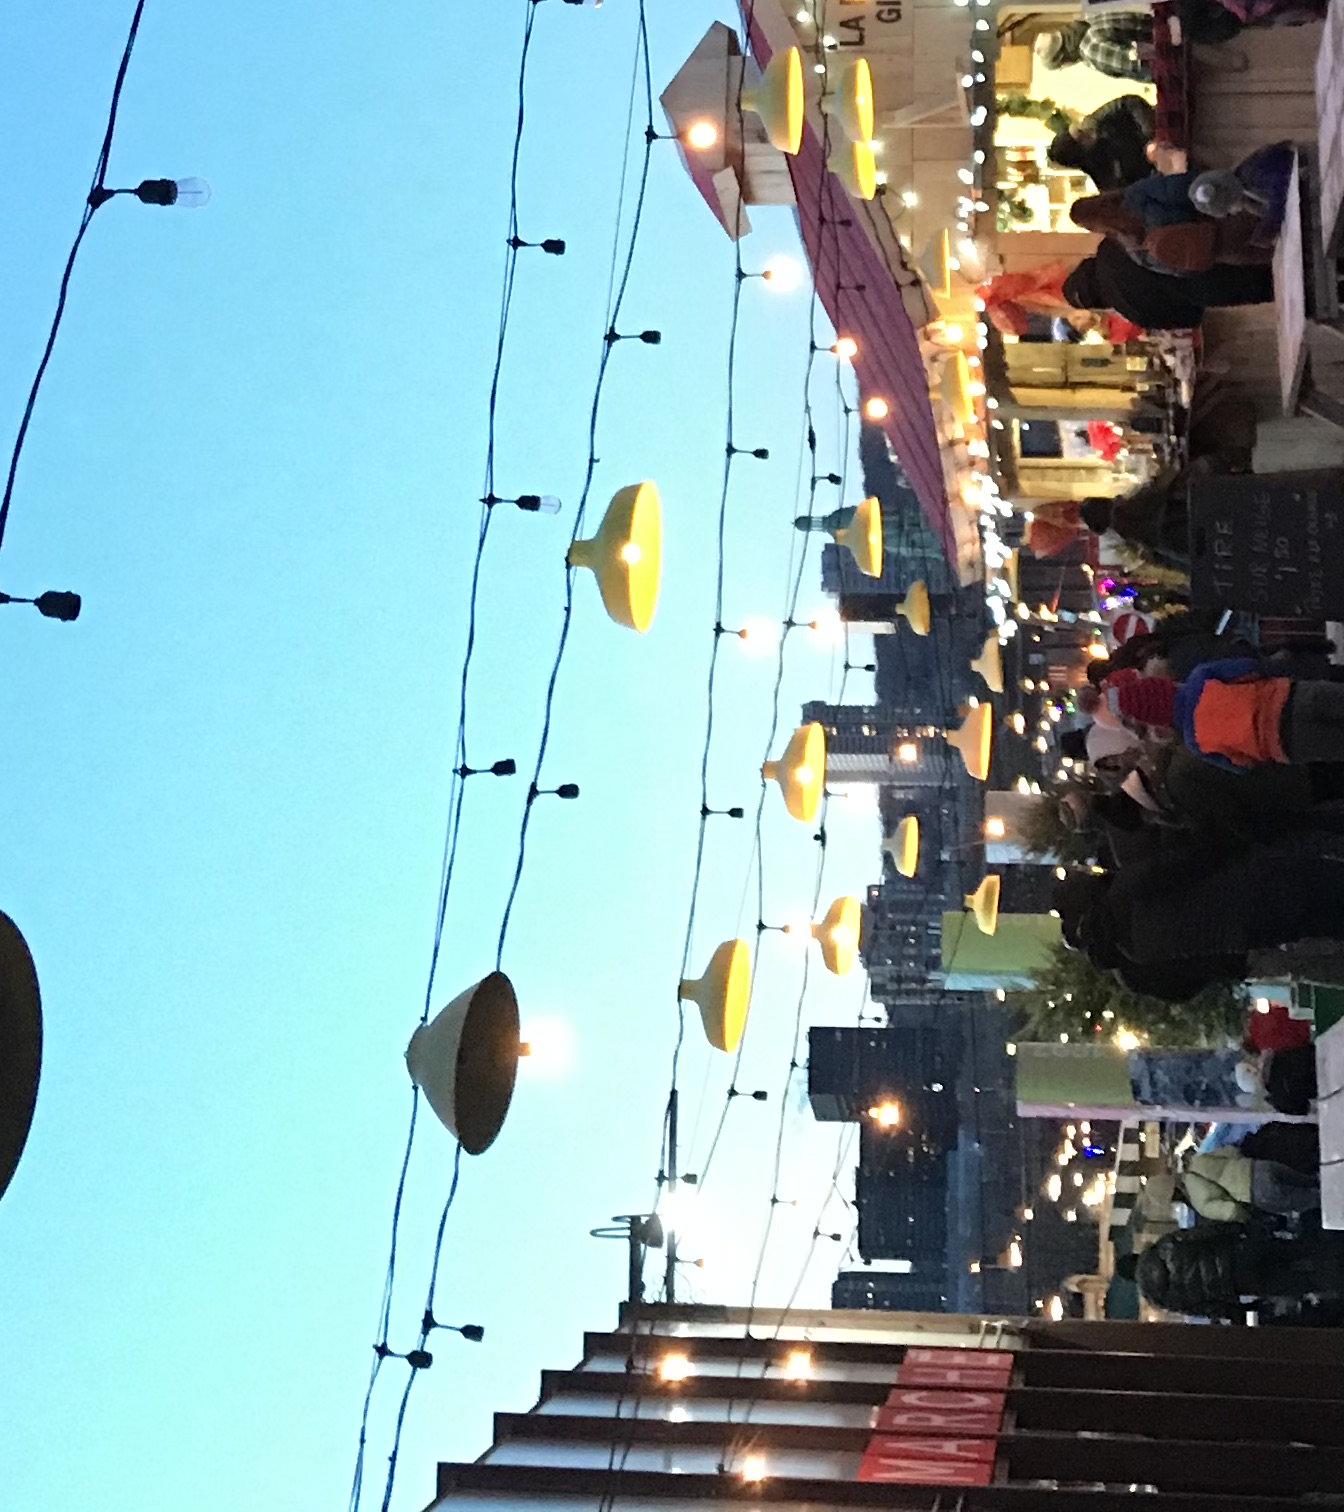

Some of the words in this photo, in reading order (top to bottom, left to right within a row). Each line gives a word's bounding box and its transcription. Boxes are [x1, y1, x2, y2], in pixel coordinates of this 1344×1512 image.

[839, 15, 866, 46] LA
[1248, 562, 1270, 602] SUR
[872, 1349, 1000, 1482] MARCHÉ
